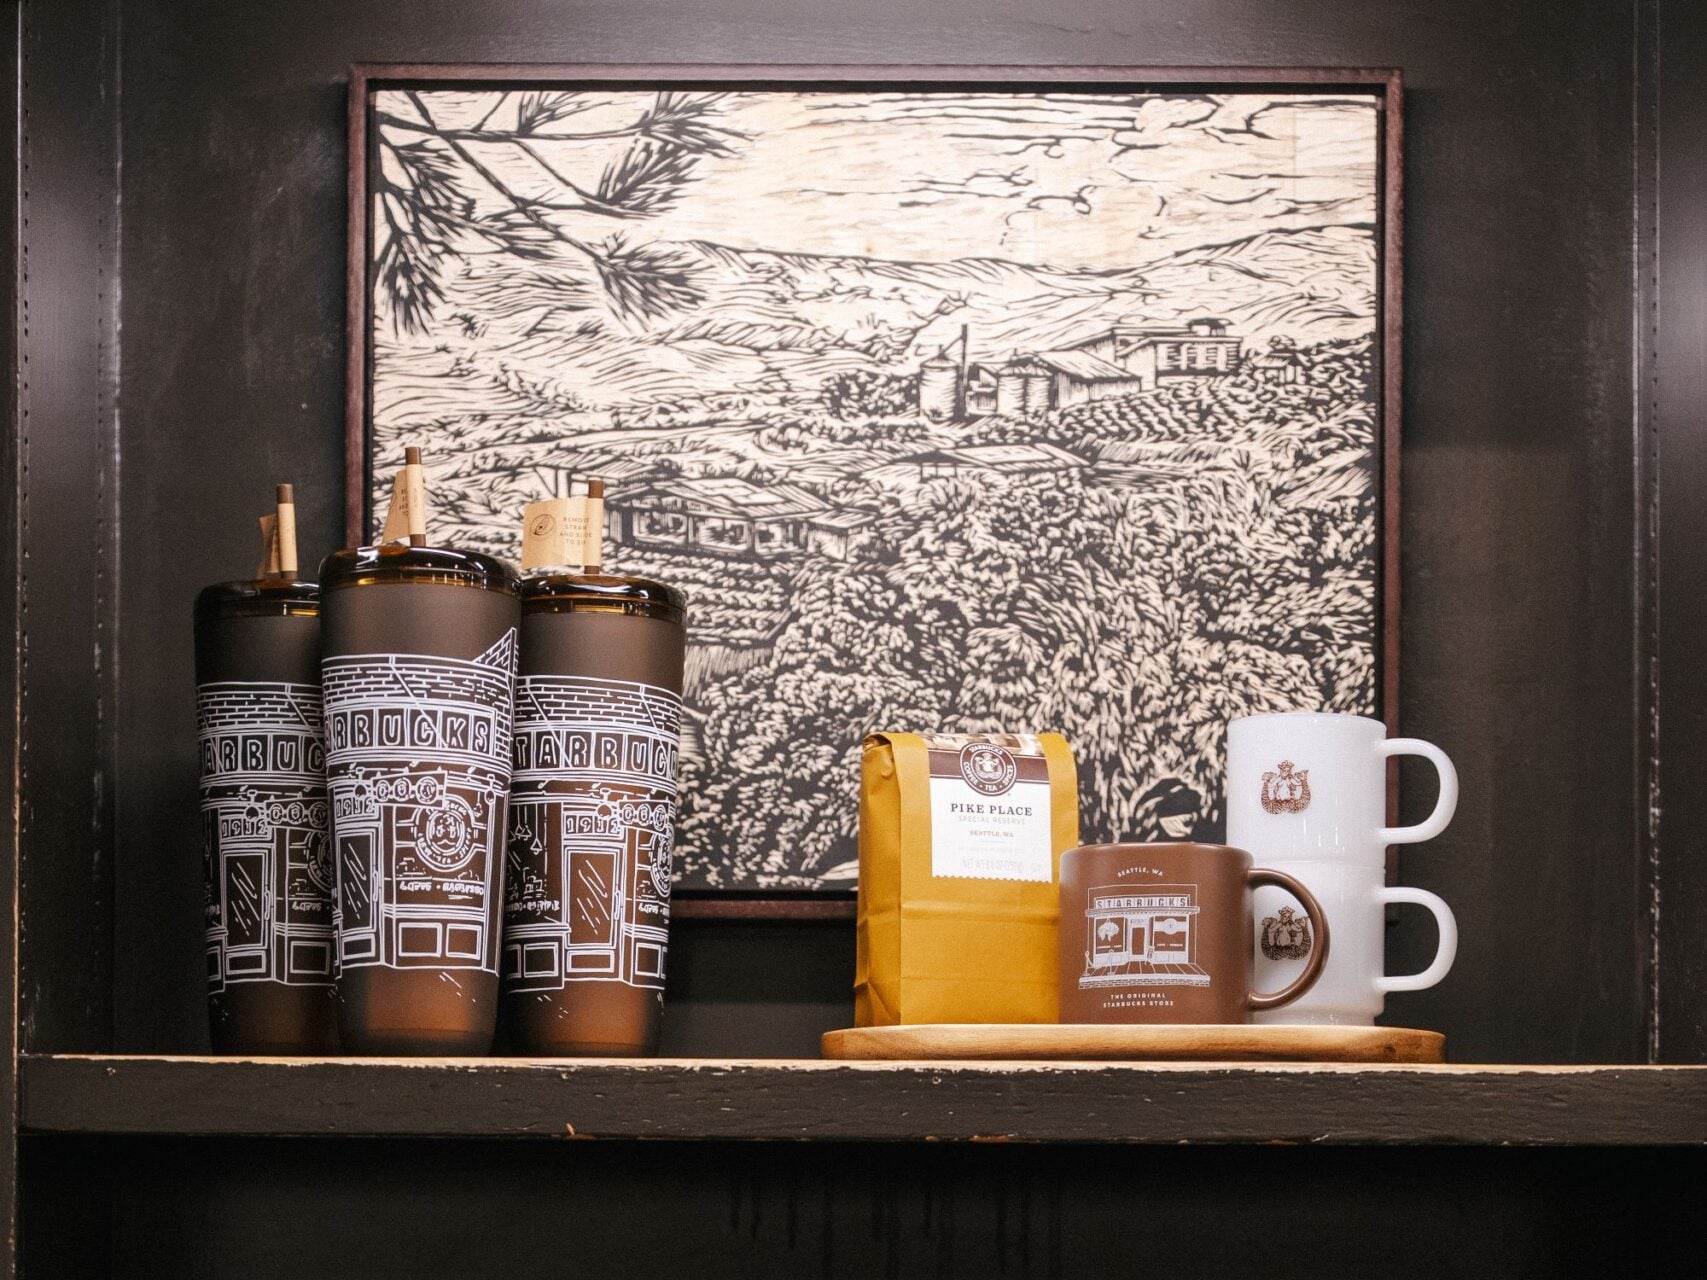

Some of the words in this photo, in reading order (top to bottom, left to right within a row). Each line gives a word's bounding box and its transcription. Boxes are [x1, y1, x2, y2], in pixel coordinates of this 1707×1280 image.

[963, 761, 978, 785] COFFEE
[1002, 765, 1013, 785] SPICES
[950, 803, 985, 813] PIKE
[989, 805, 1032, 816] PLACE
[958, 815, 989, 823] SPECIAL
[992, 817, 1025, 825] RESERVE
[1118, 867, 1149, 877] SEATTLE,
[1152, 868, 1163, 876] WA
